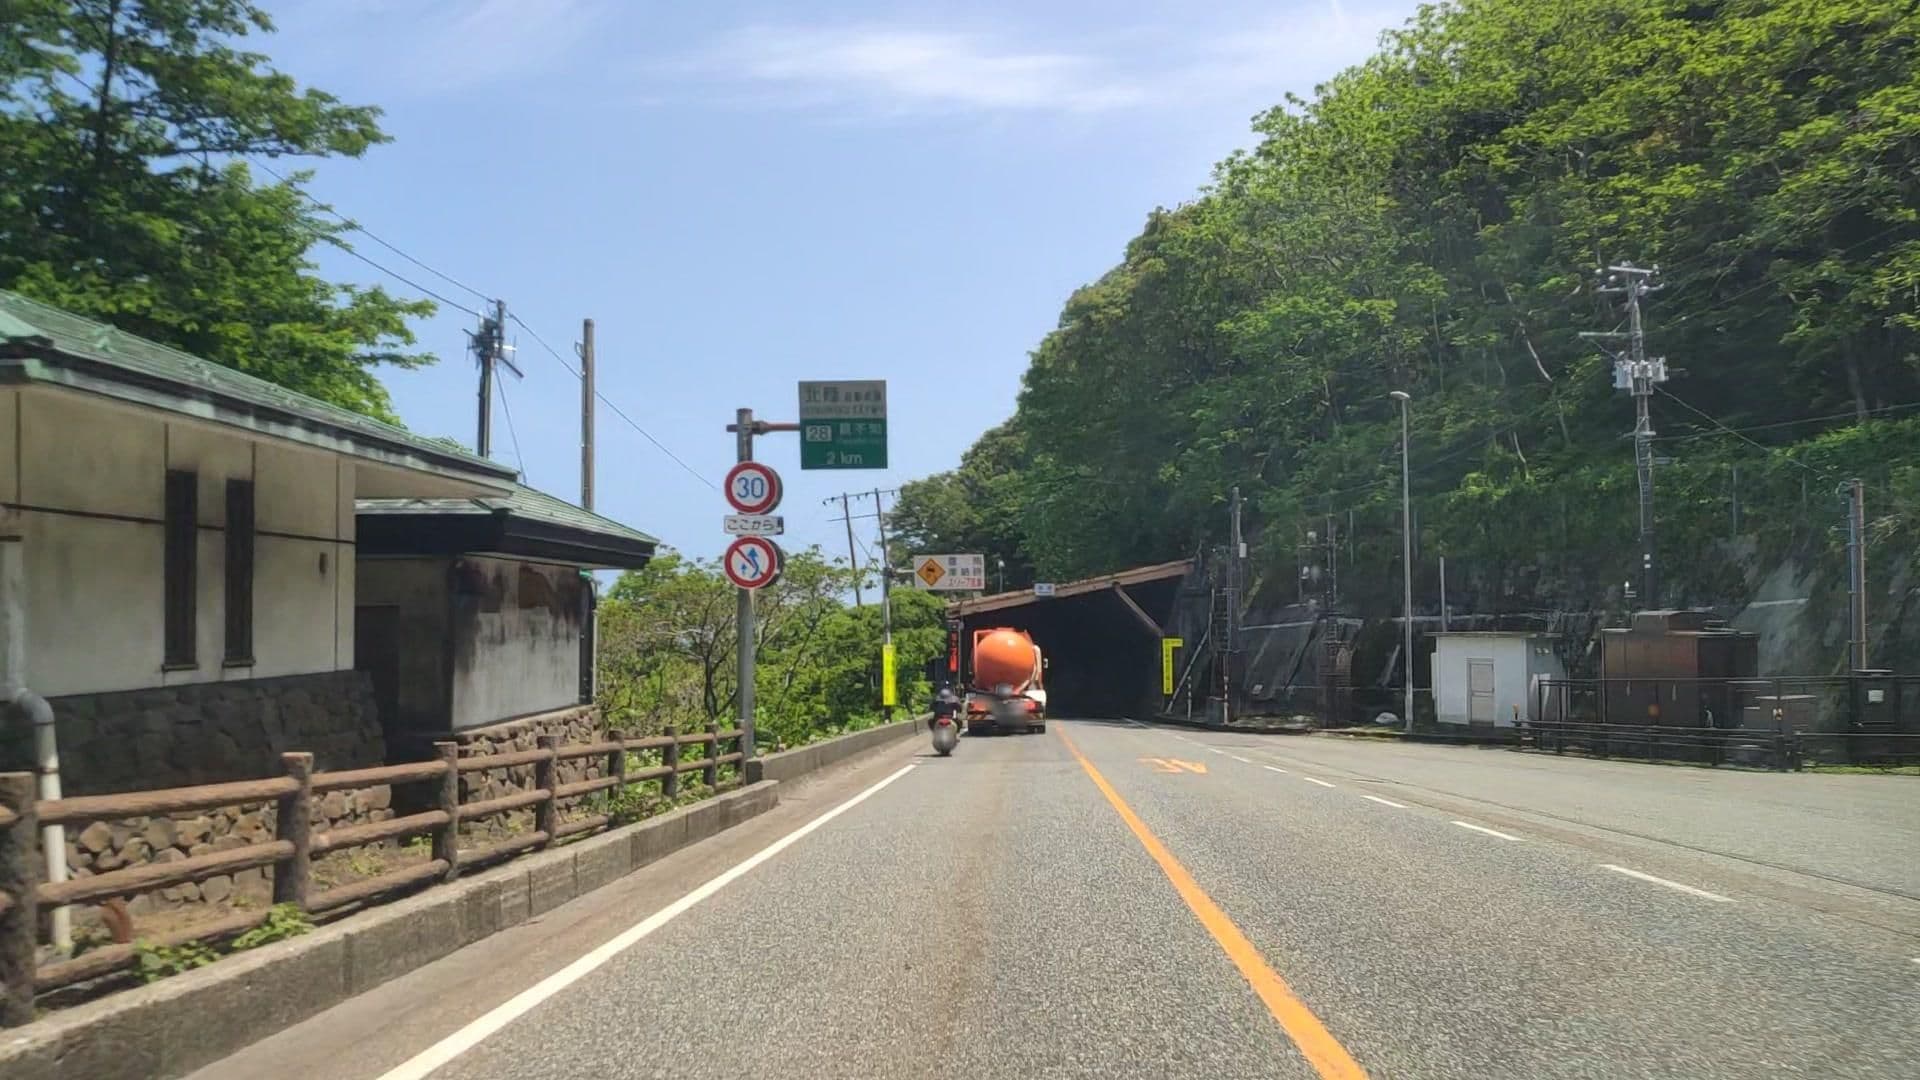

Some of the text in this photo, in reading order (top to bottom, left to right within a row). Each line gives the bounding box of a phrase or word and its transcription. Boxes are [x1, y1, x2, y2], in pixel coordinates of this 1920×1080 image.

[809, 426, 830, 441] 28
[826, 450, 863, 465] 2 km
[736, 477, 765, 499] 30
[727, 518, 775, 531] ここから
